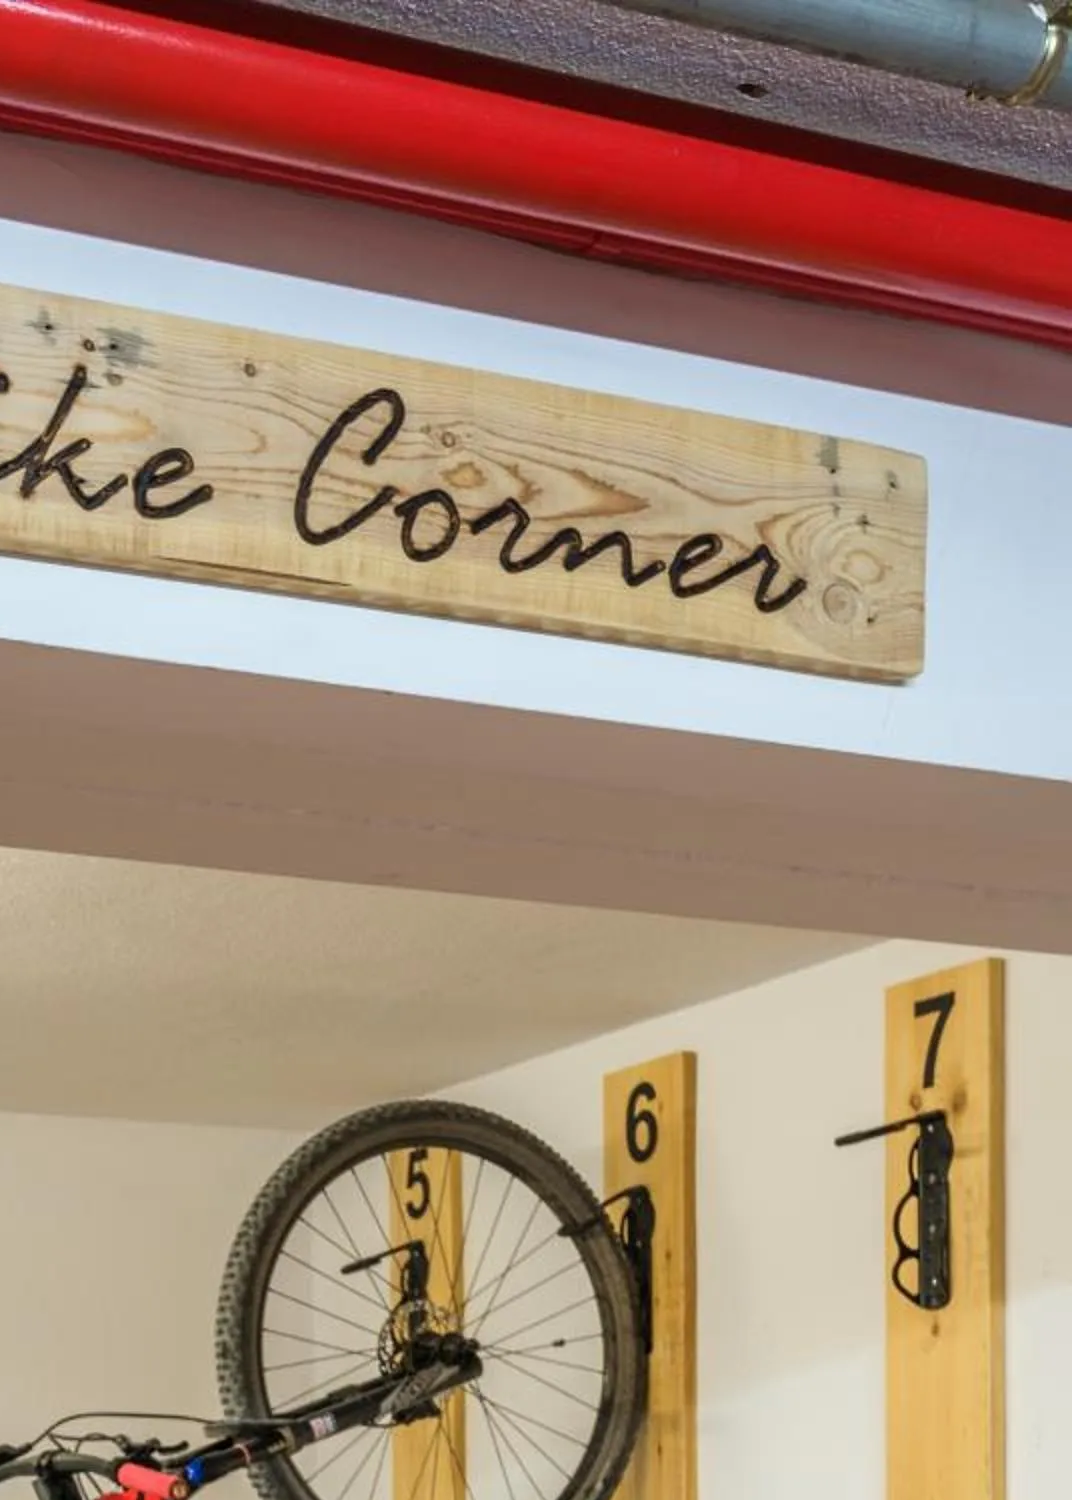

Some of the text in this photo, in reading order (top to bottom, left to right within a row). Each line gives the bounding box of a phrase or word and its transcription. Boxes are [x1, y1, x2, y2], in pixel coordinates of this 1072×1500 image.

[294, 388, 807, 613] Corner
[913, 991, 956, 1089] 7
[625, 1081, 658, 1164] 6
[404, 1149, 432, 1220] 5
